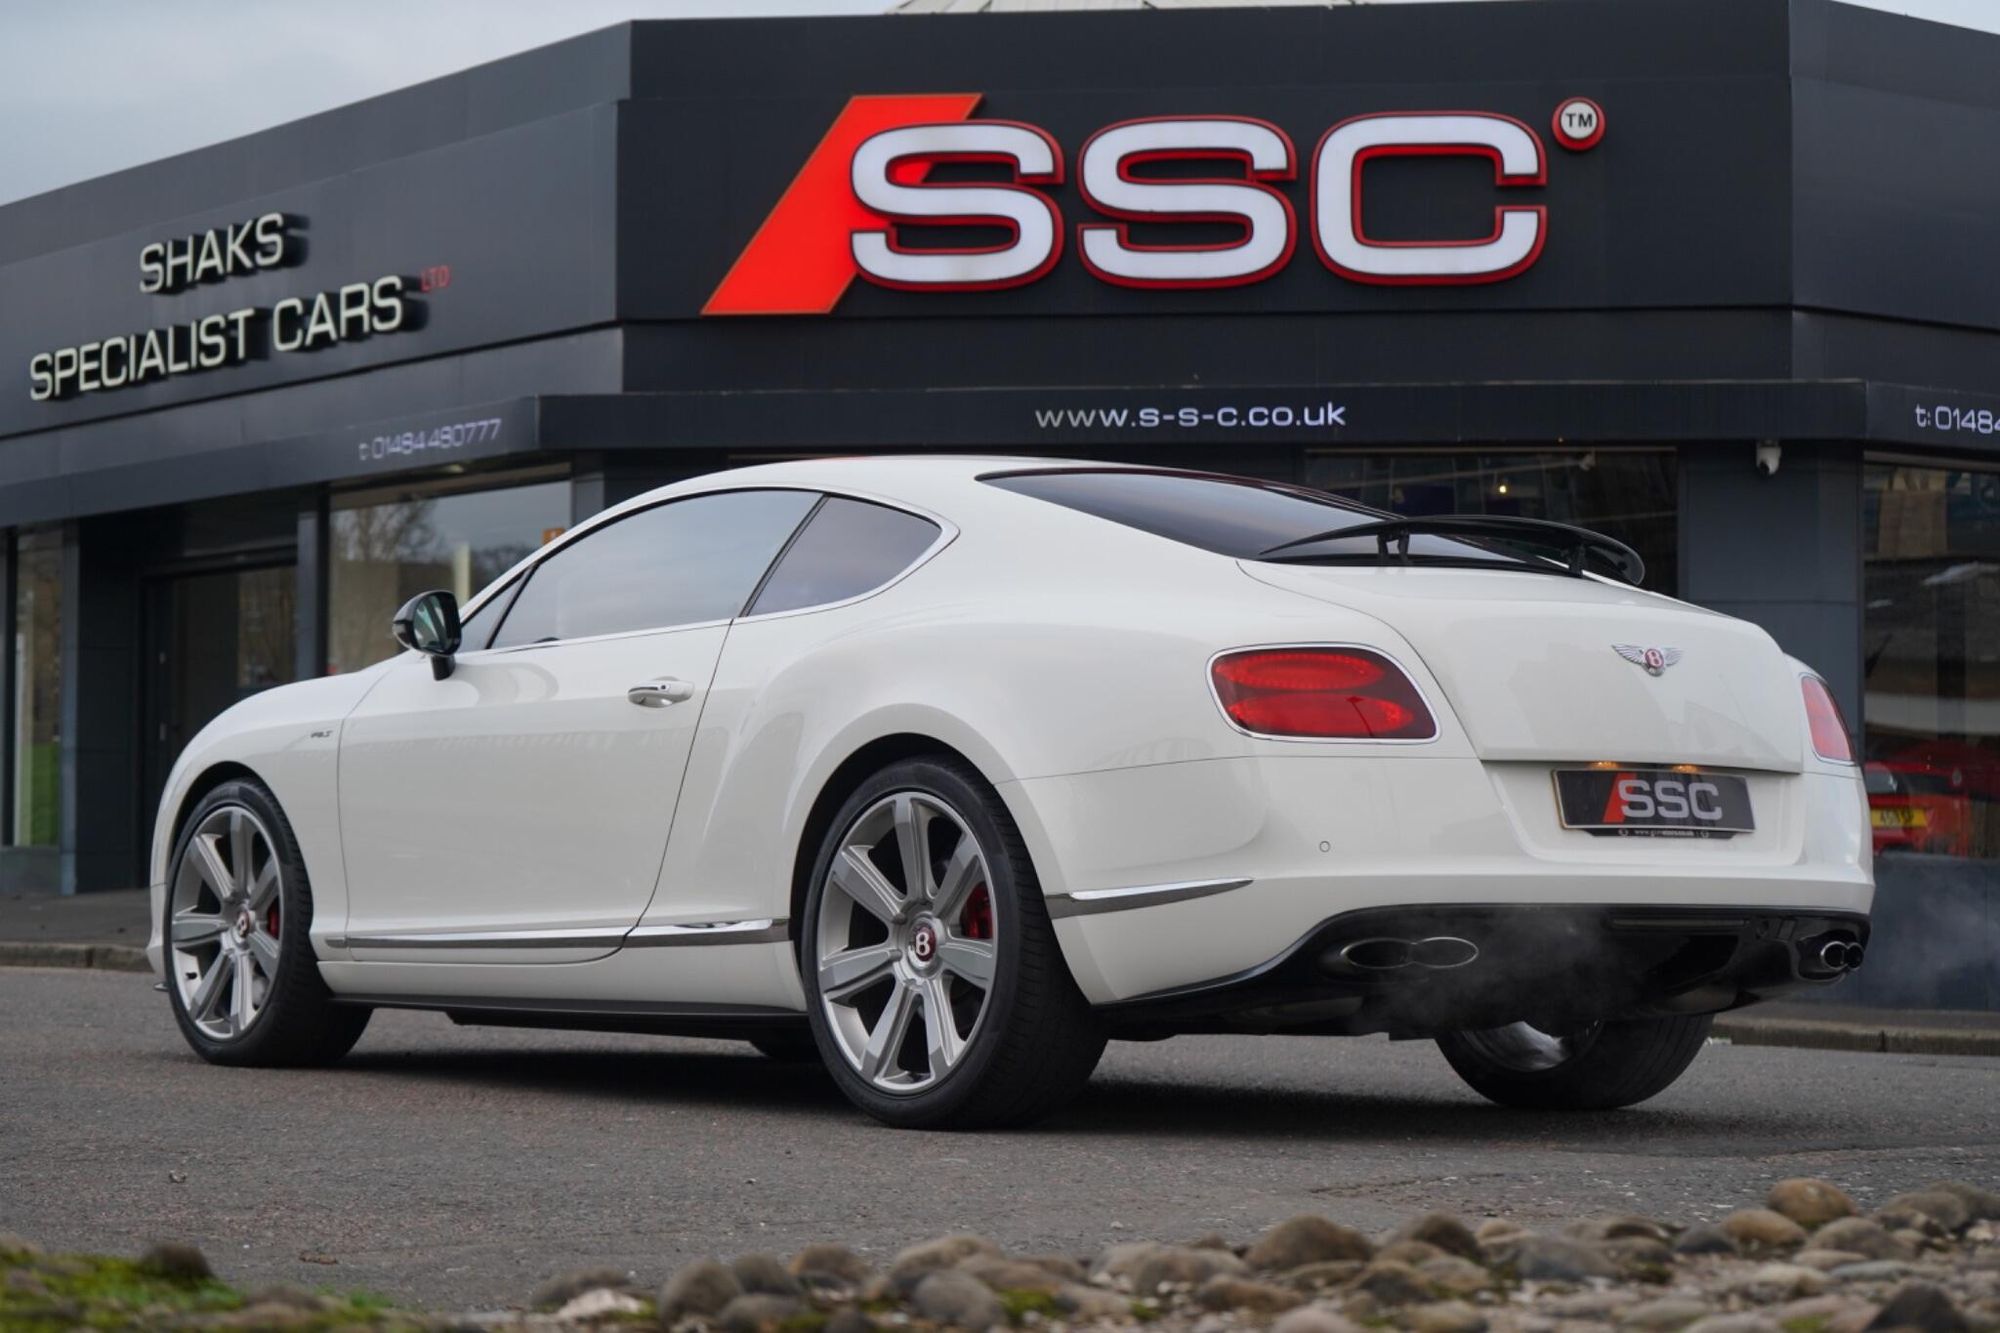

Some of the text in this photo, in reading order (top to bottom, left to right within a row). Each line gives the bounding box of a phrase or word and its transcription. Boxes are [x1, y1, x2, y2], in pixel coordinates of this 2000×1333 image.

[850, 111, 1592, 290] SSC TM
[139, 213, 284, 293] SHAKS
[30, 264, 450, 400] SPECIALIST CARS LTD
[1035, 402, 1346, 427] www.s-s-c.co.uk
[1618, 779, 1723, 820] SSC
